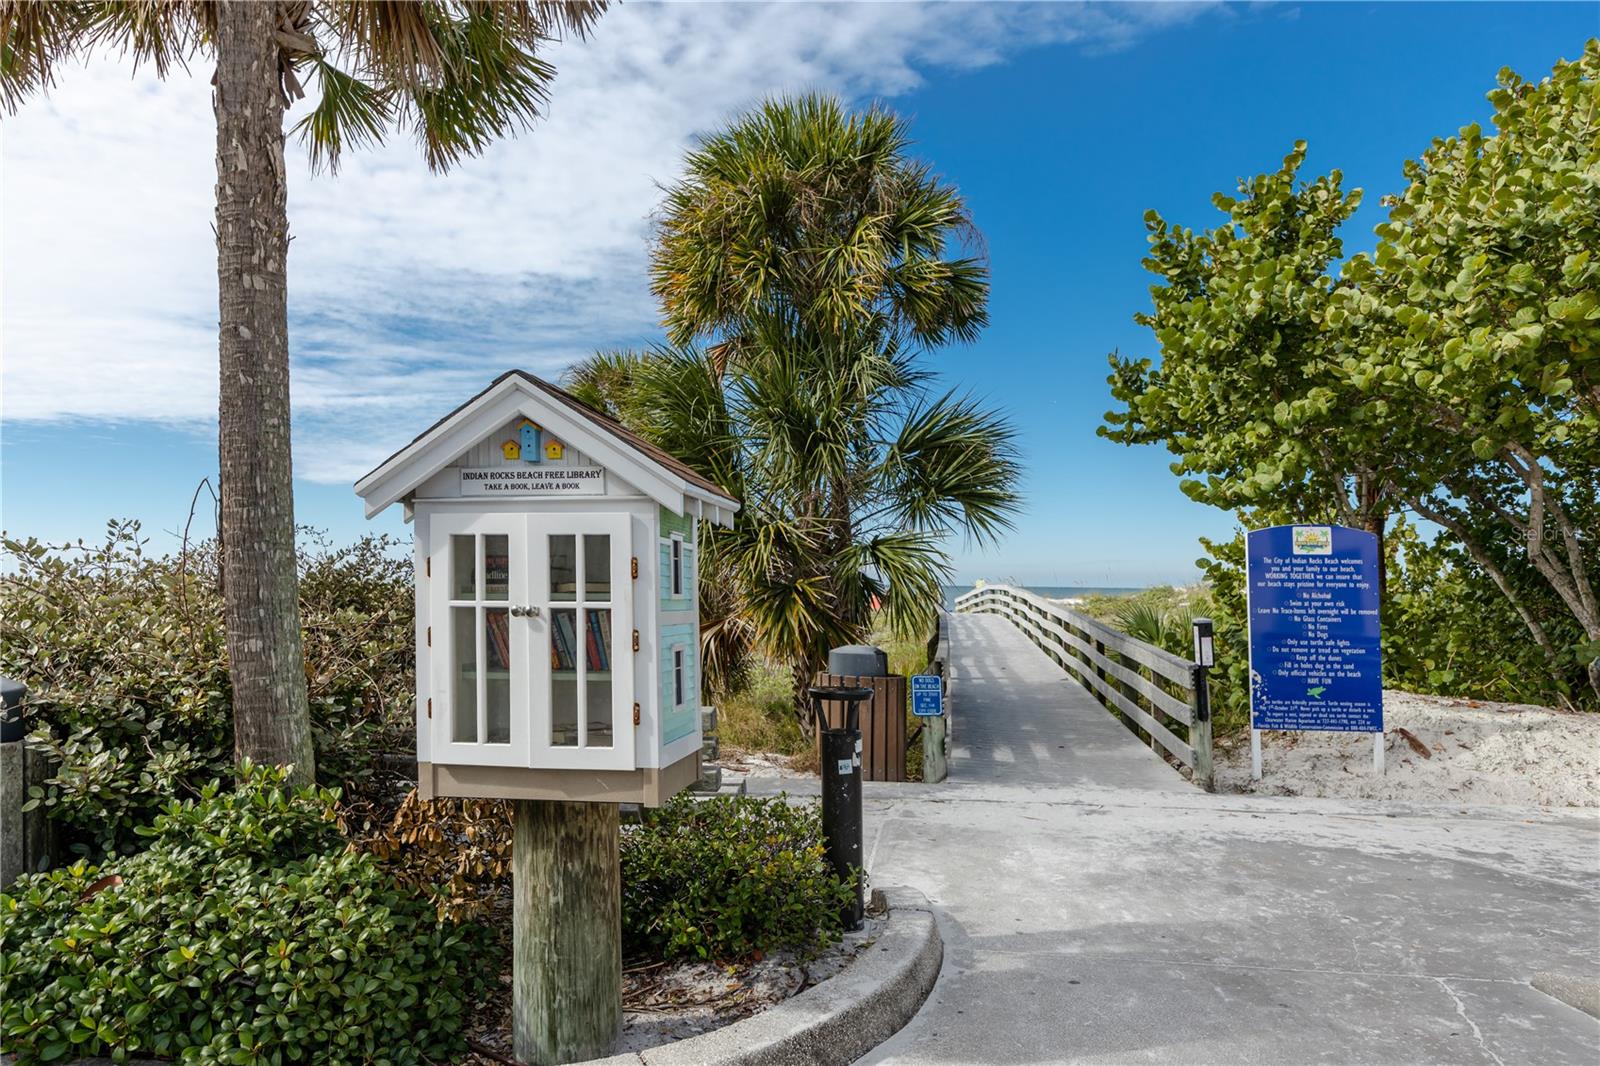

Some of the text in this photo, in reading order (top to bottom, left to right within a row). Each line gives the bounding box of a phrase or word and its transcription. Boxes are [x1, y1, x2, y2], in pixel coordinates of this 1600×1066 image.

[463, 470, 602, 480] INDIAN ROCKS BEACH FREE LIBRARY
[511, 483, 531, 491] BOOK,
[531, 482, 554, 490] LEAVE
[1274, 558, 1282, 566] City
[1318, 608, 1339, 616] overnight
[1278, 670, 1288, 678] Only
